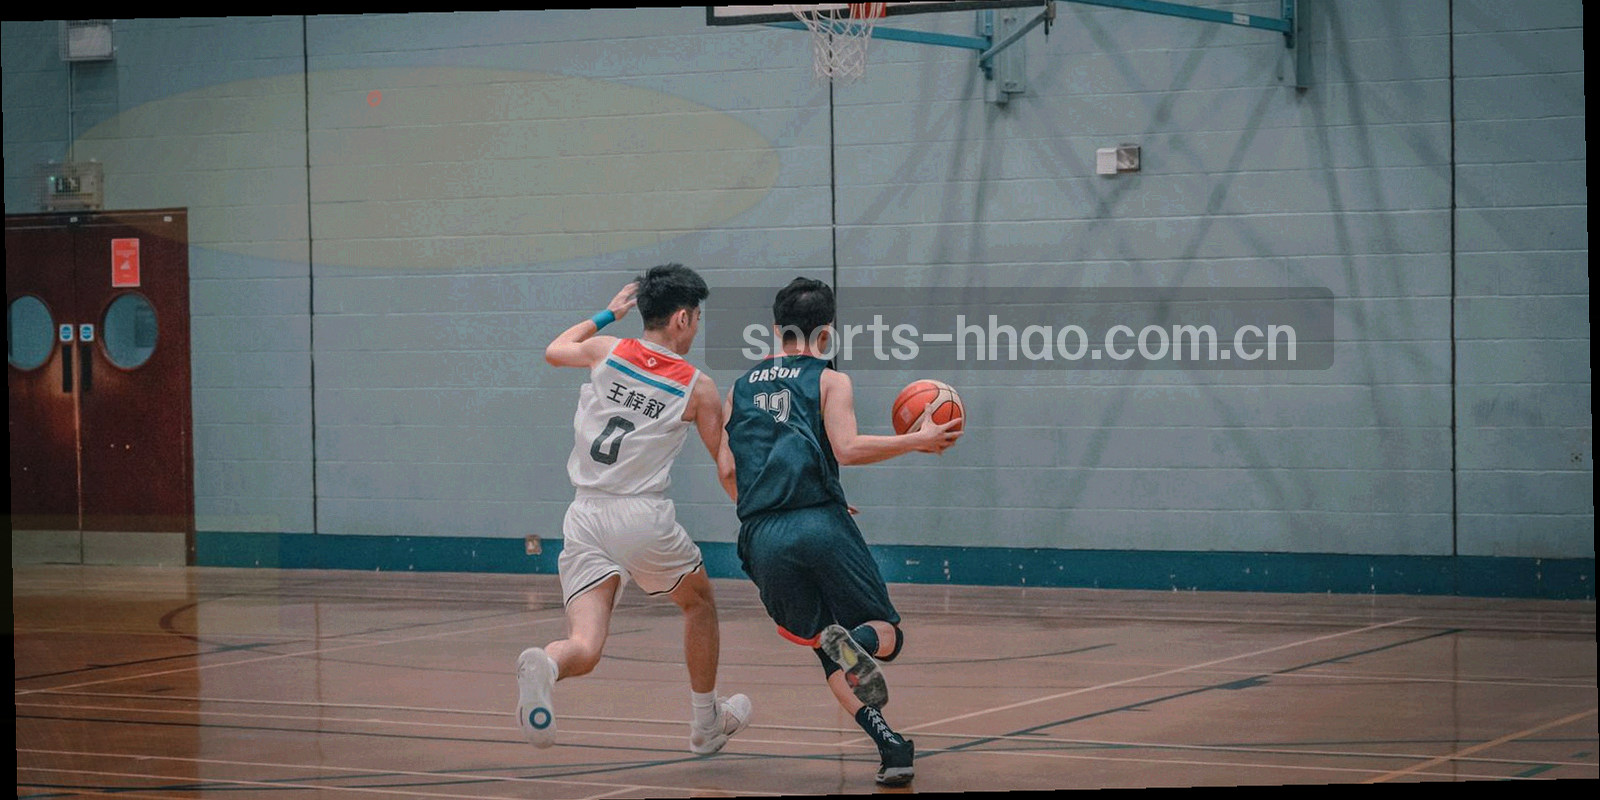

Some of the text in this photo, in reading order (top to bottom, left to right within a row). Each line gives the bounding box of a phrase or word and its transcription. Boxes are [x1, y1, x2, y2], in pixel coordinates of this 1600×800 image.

[748, 366, 801, 383] CASON
[606, 381, 666, 420] 王梓叙
[589, 415, 636, 466] 0
